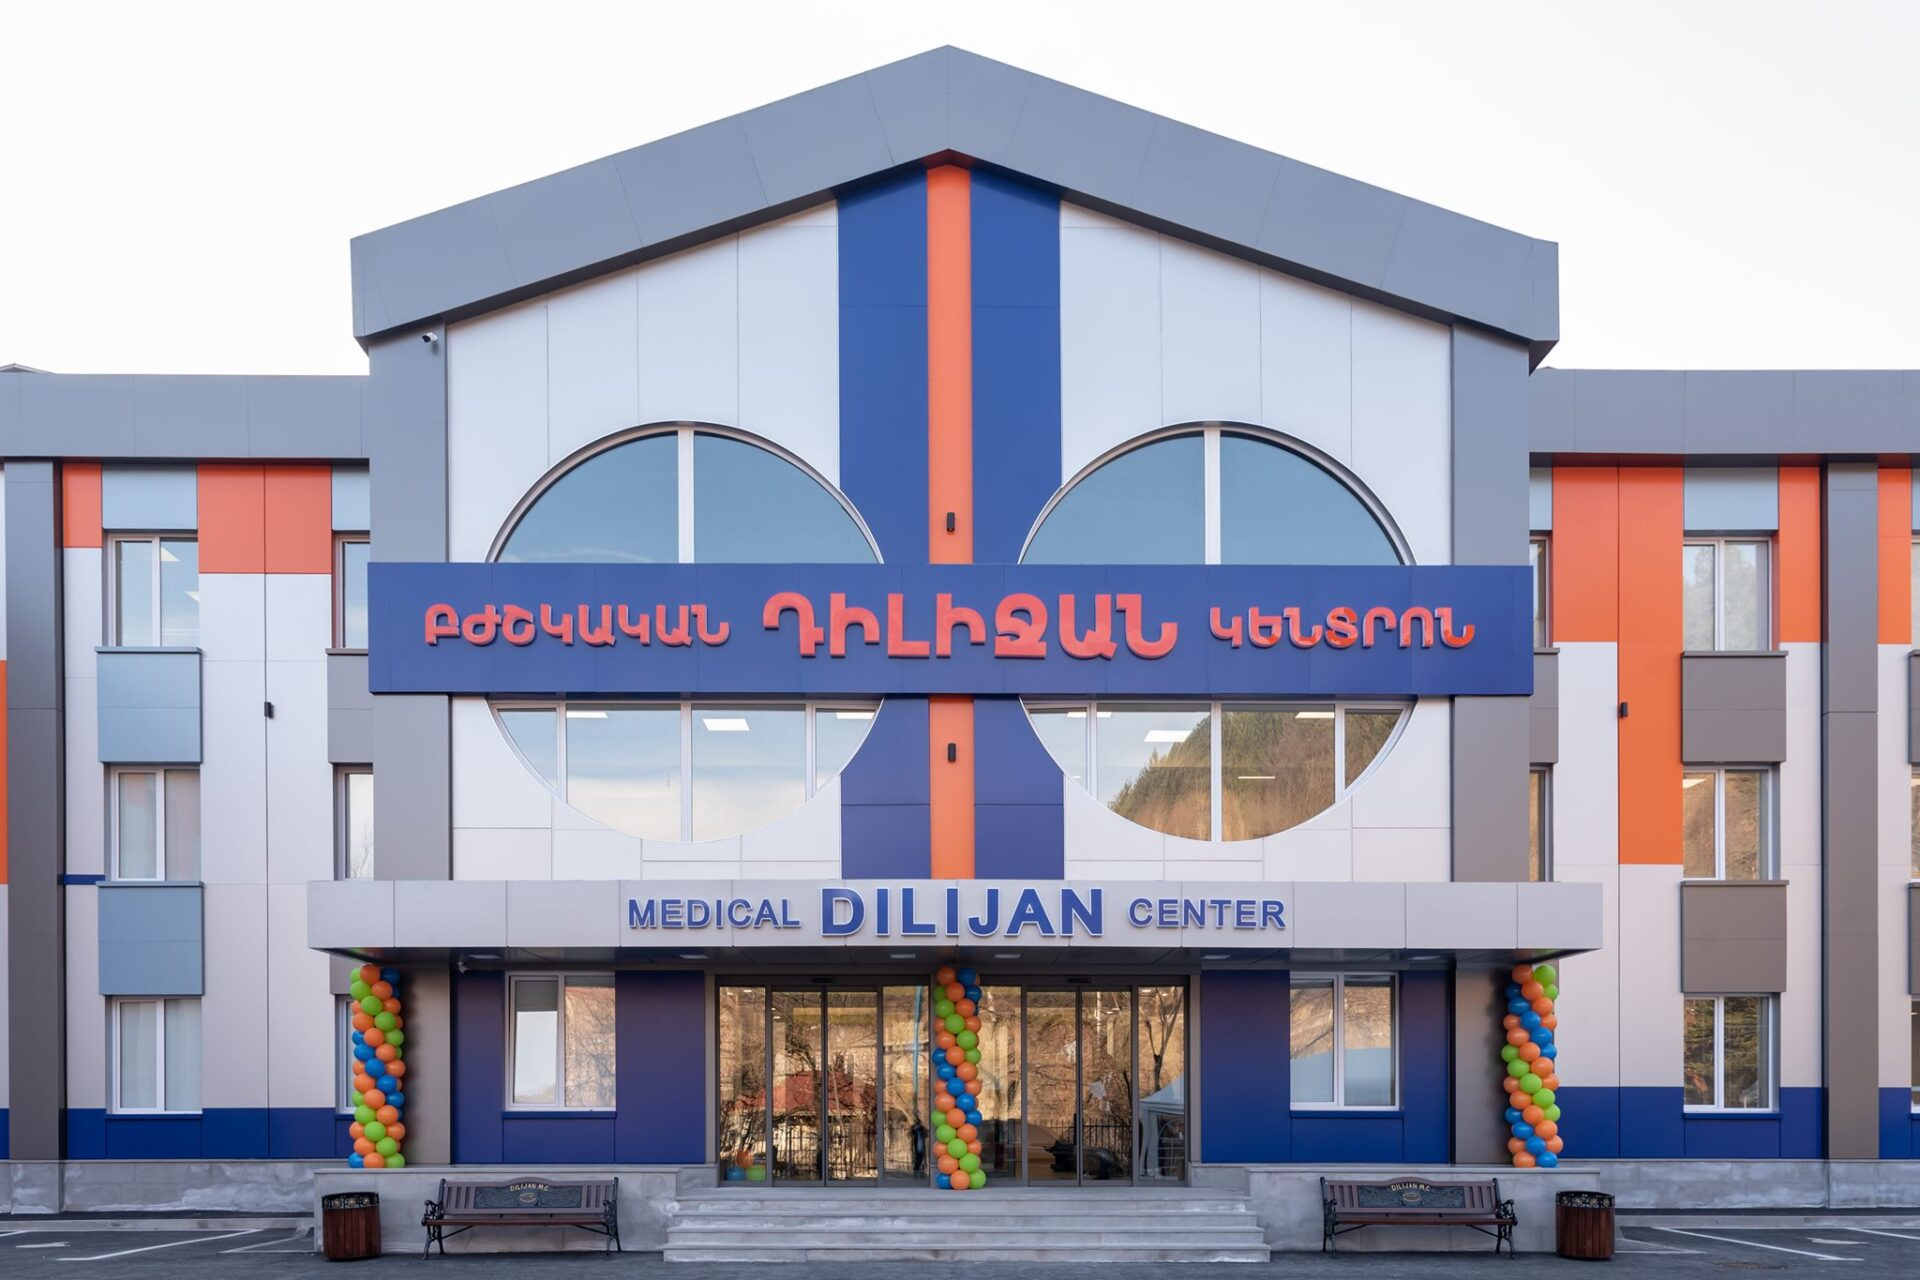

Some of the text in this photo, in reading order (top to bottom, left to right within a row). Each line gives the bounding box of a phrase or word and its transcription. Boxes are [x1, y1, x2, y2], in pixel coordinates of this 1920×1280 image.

[424, 591, 1476, 659] ԲԺՇԿԱԿԱՆ ԴԻԼԻՋԱՆ ԿԵՆՏՐՈՆ
[627, 886, 1288, 938] MEDICAL DILIJAN CENTER
[509, 1183, 536, 1192] DILIJAN
[1390, 1183, 1418, 1192] DILIJAN
